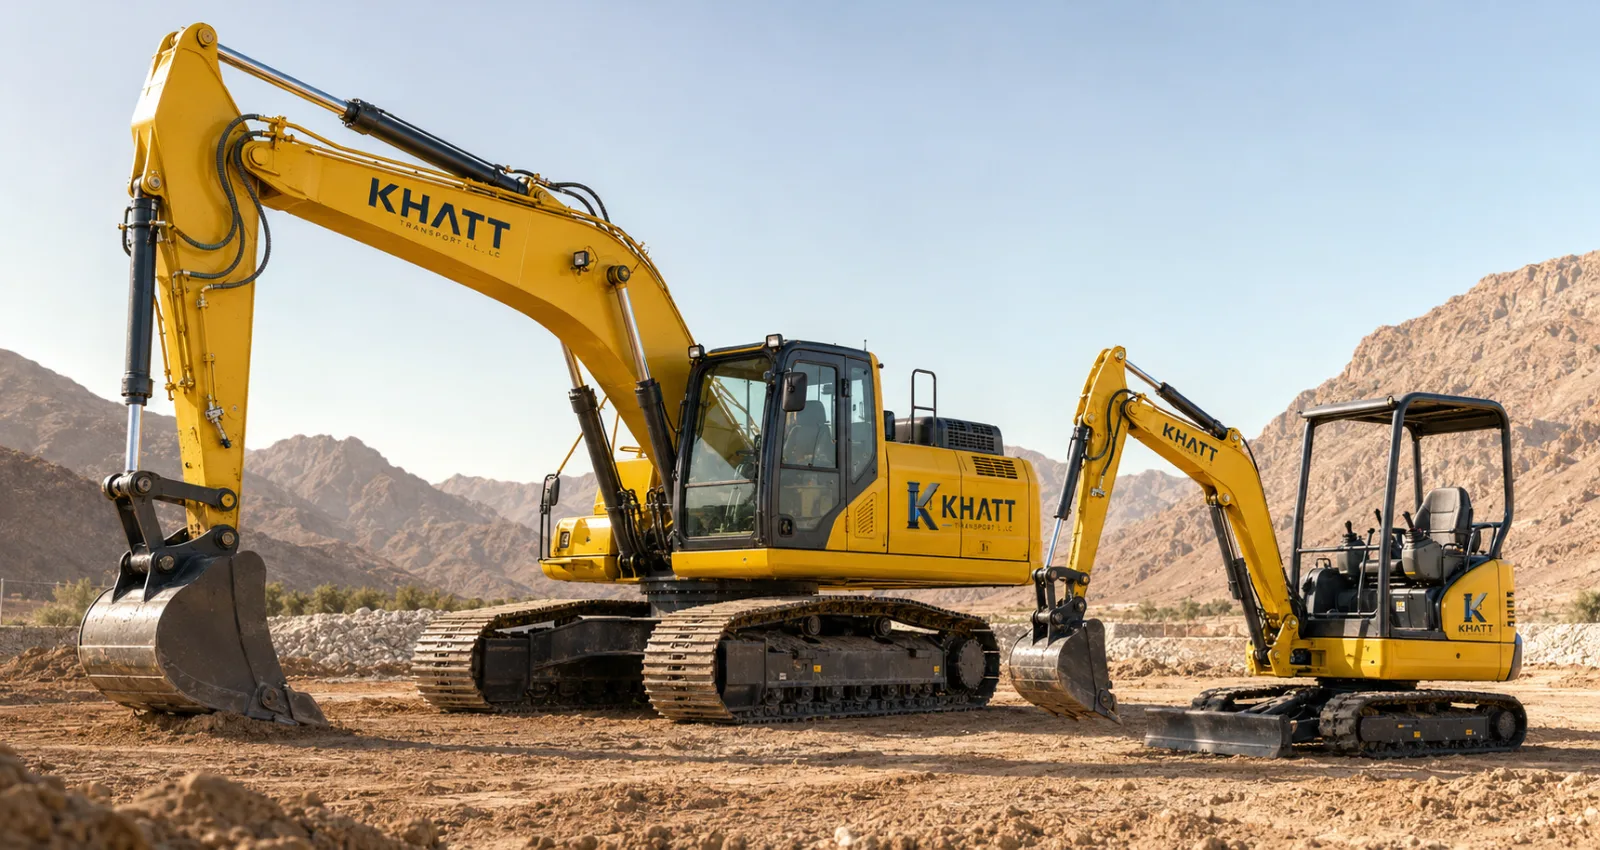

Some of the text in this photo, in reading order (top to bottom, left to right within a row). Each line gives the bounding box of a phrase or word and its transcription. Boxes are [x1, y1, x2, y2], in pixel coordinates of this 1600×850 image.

[368, 177, 511, 250] KHATT
[400, 220, 462, 245] TRANSPORT
[1162, 422, 1219, 462] KHATT
[942, 495, 1016, 523] KHATT
[1458, 624, 1494, 633] KHATT
